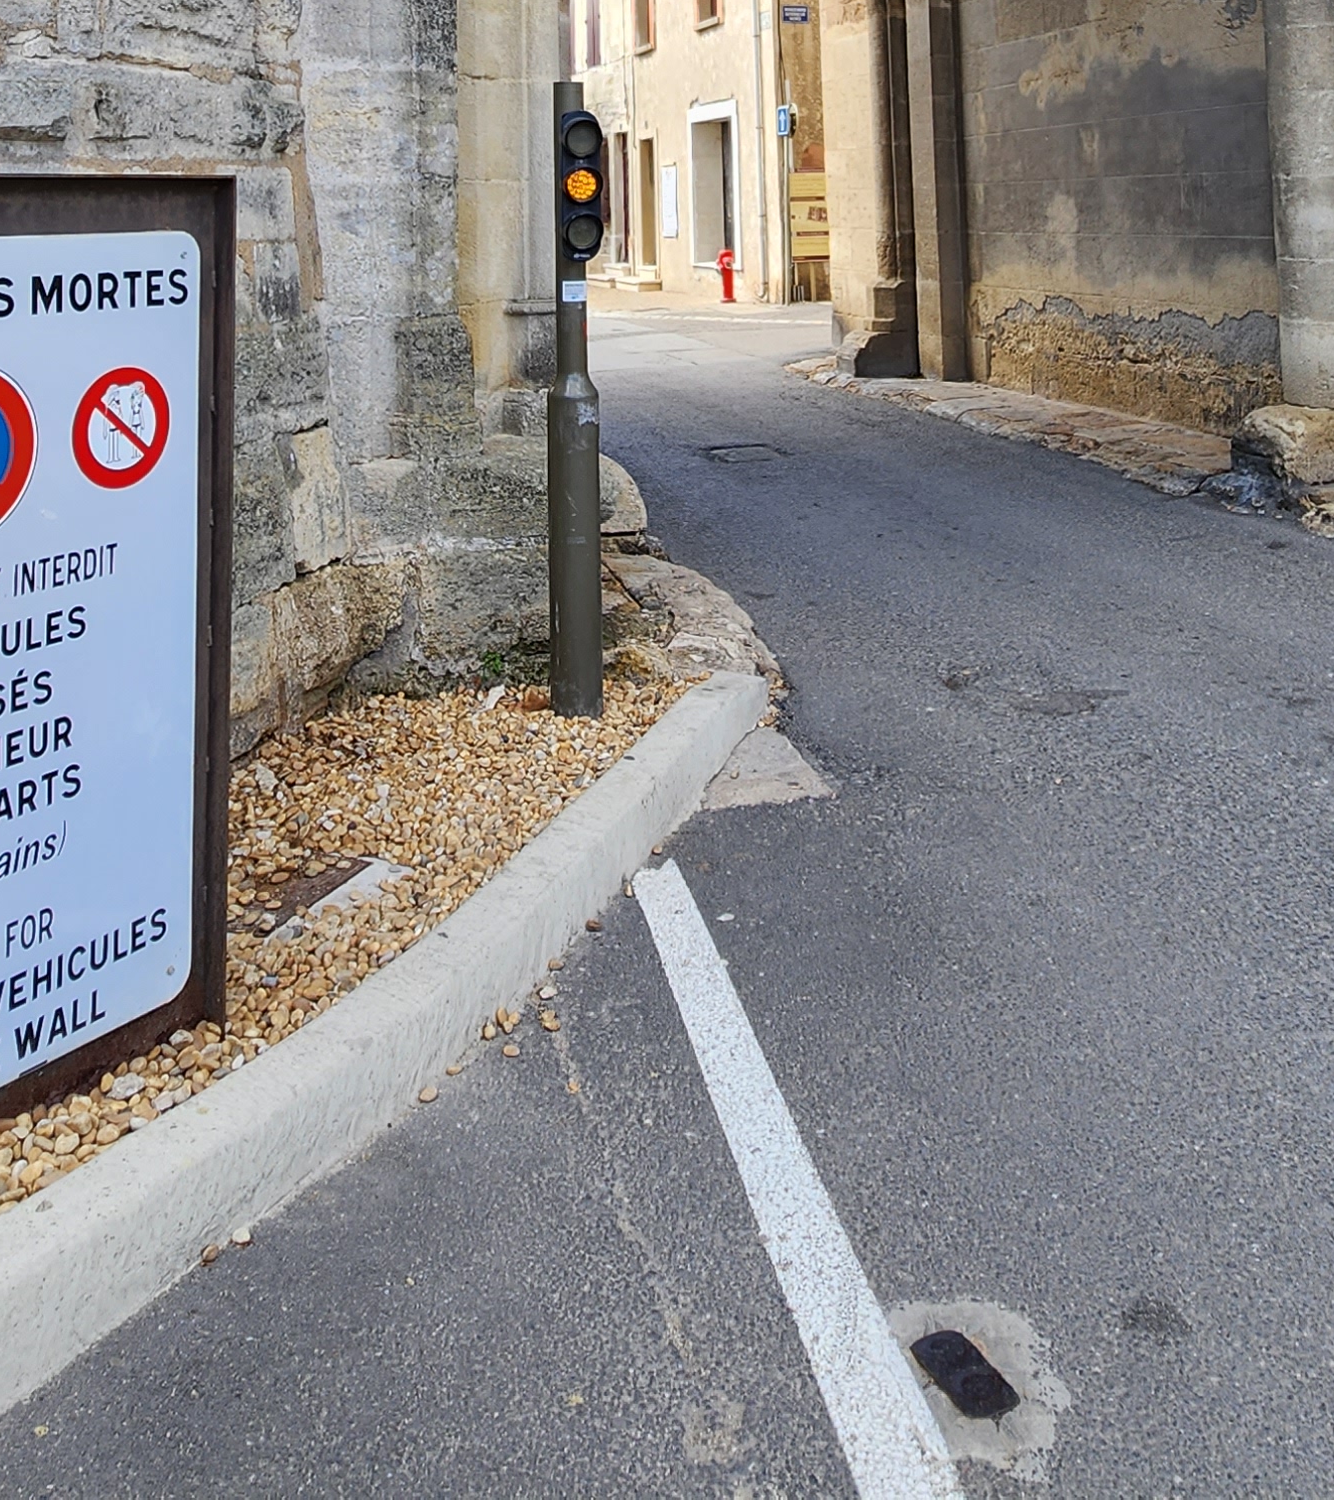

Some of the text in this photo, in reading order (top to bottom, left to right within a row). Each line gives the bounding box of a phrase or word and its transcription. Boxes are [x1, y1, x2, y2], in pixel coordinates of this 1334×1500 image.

[32, 269, 188, 314] MORTES
[14, 543, 117, 596] INTERDIT
[6, 908, 53, 957] FOR
[15, 990, 105, 1060] WALL
